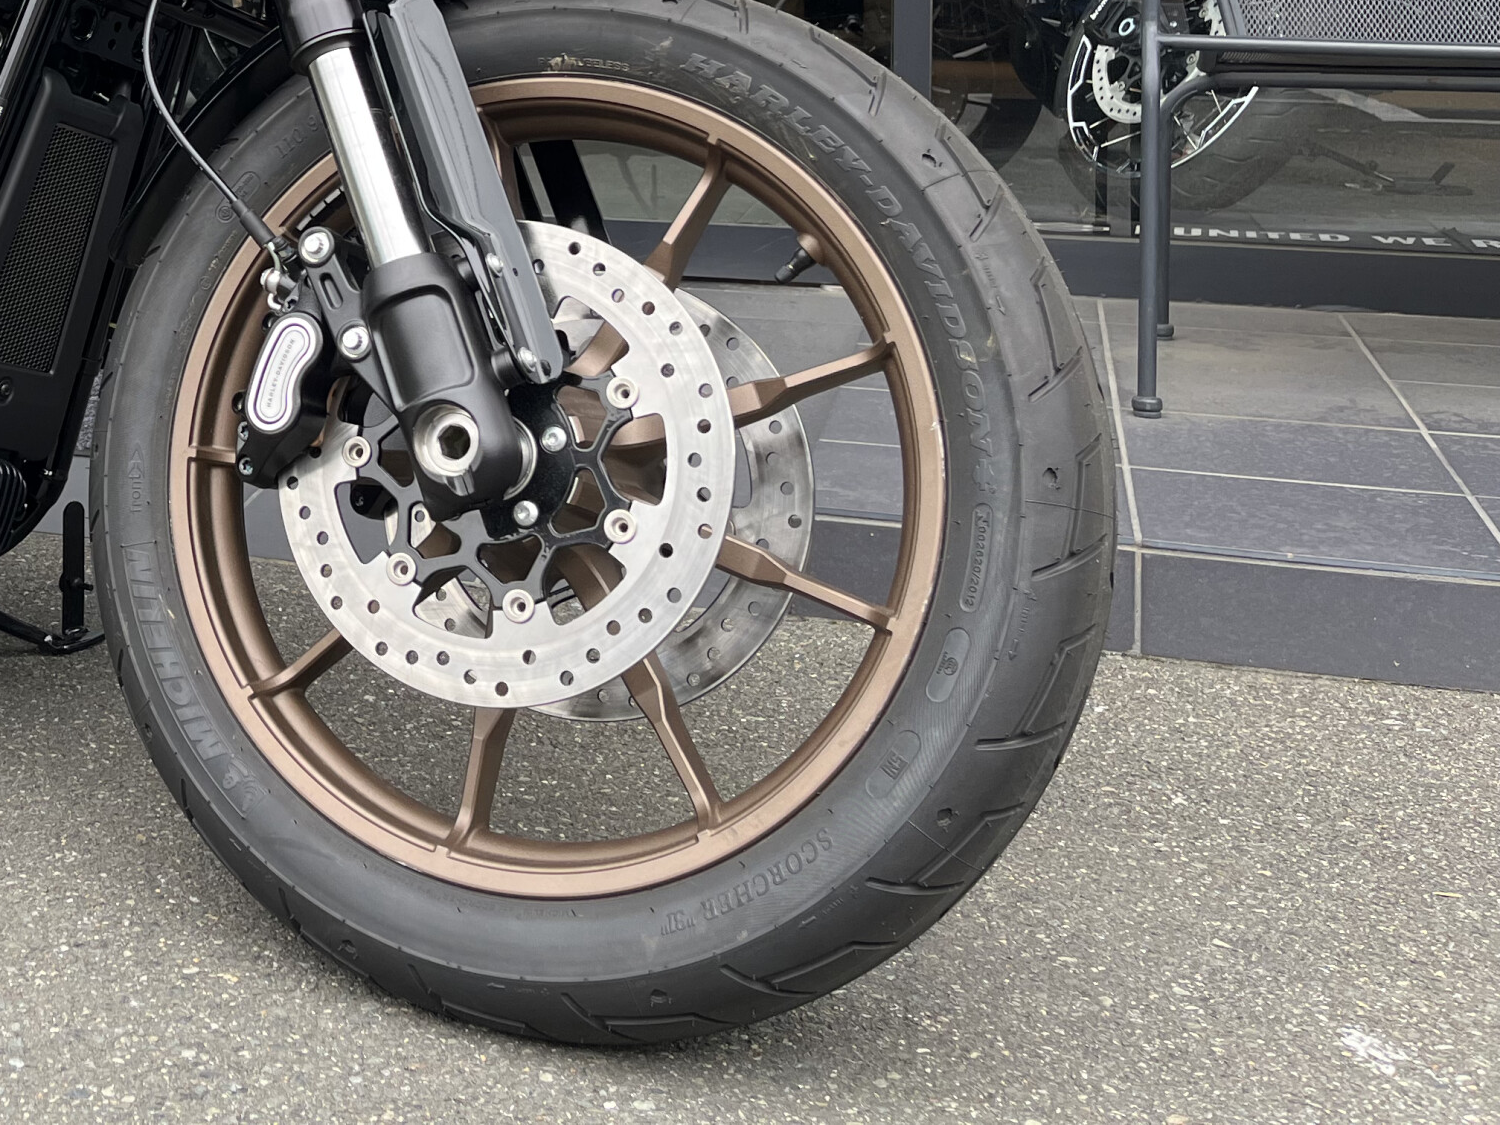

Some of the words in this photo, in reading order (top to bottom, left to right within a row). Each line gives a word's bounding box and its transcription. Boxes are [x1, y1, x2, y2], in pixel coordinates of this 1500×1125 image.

[679, 52, 994, 458] HARLEY-DAVIDSON
[1173, 226, 1351, 243] UNITED
[1371, 234, 1453, 247] WE
[266, 338, 296, 408] HARLEY-DAVIDSON
[126, 548, 229, 761] MICHELIN
[701, 827, 834, 921] SCORCHER
